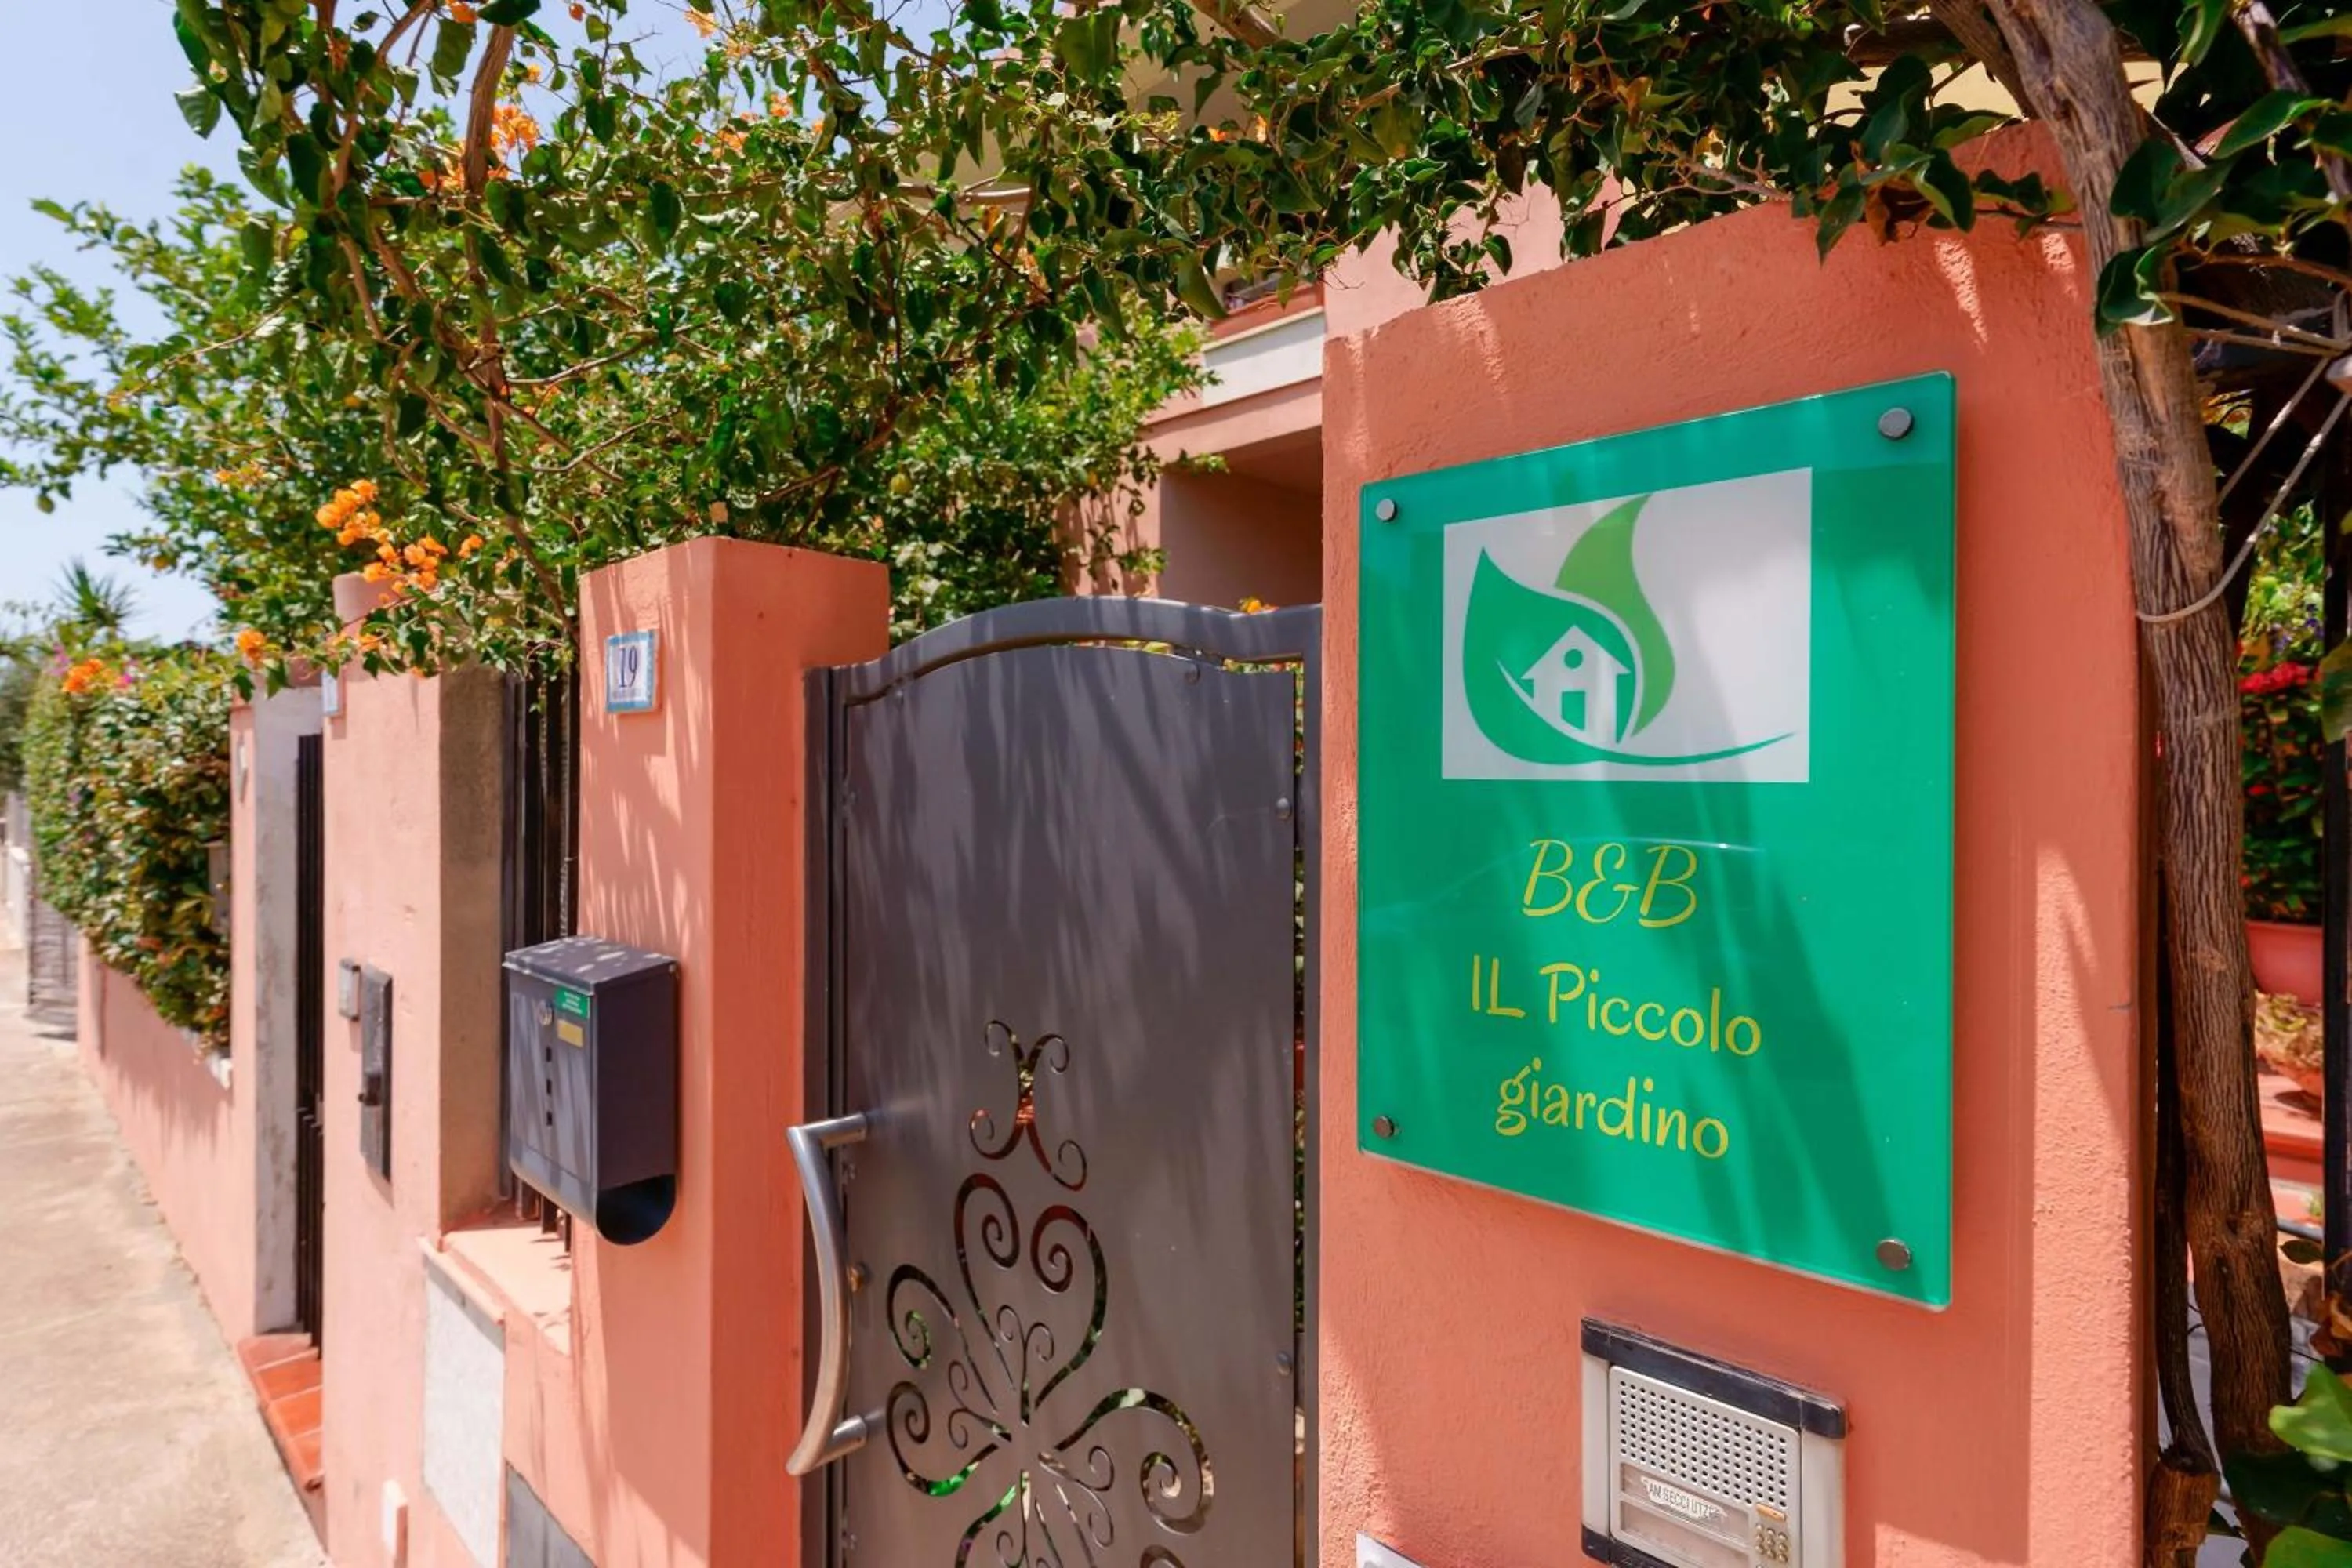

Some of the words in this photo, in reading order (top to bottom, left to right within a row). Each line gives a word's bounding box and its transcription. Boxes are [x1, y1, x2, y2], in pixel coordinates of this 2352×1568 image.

[619, 646, 637, 688] 19
[1522, 839, 1698, 927] B&B
[1471, 954, 1526, 1018] IL
[1539, 961, 1761, 1056] Piccolo
[1495, 1056, 1729, 1158] giardino
